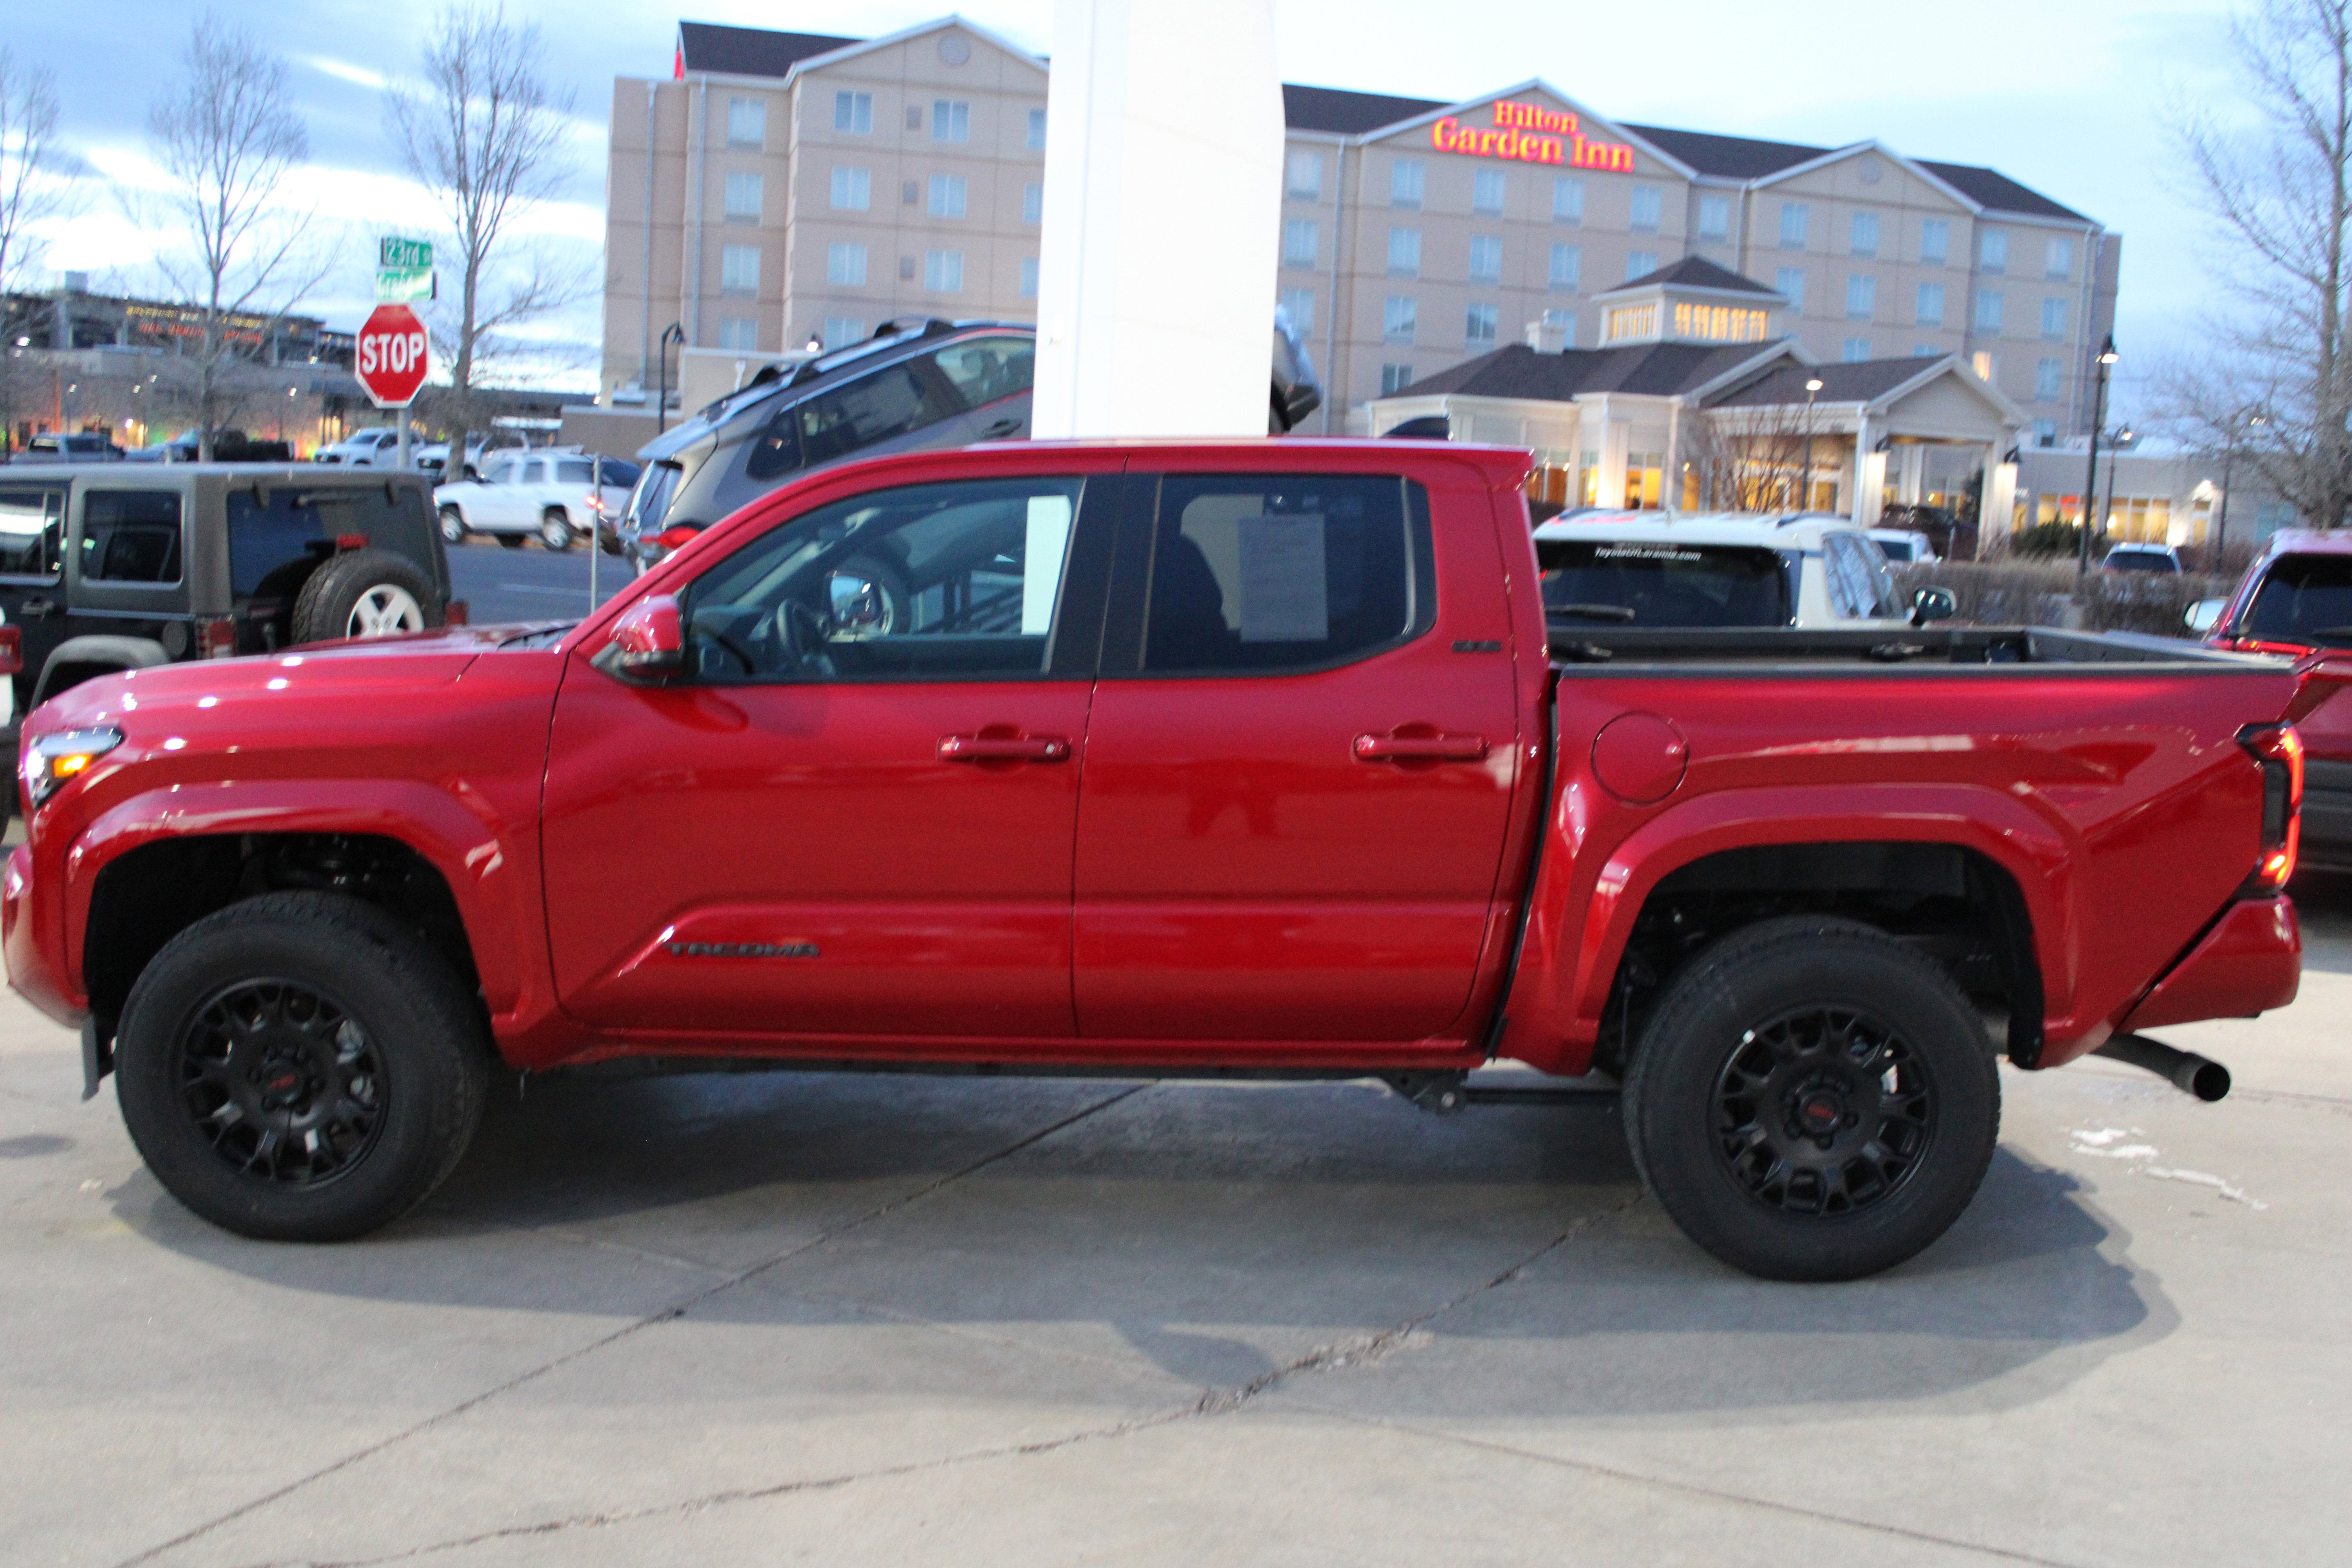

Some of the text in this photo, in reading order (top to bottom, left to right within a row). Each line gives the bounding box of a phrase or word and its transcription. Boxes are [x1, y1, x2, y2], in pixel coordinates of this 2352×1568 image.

[1492, 100, 1579, 135] Hilton
[1431, 116, 1635, 173] Garden Inn
[386, 238, 420, 267] 23rd
[362, 332, 425, 374] STOP
[662, 942, 820, 957] TACOMA
